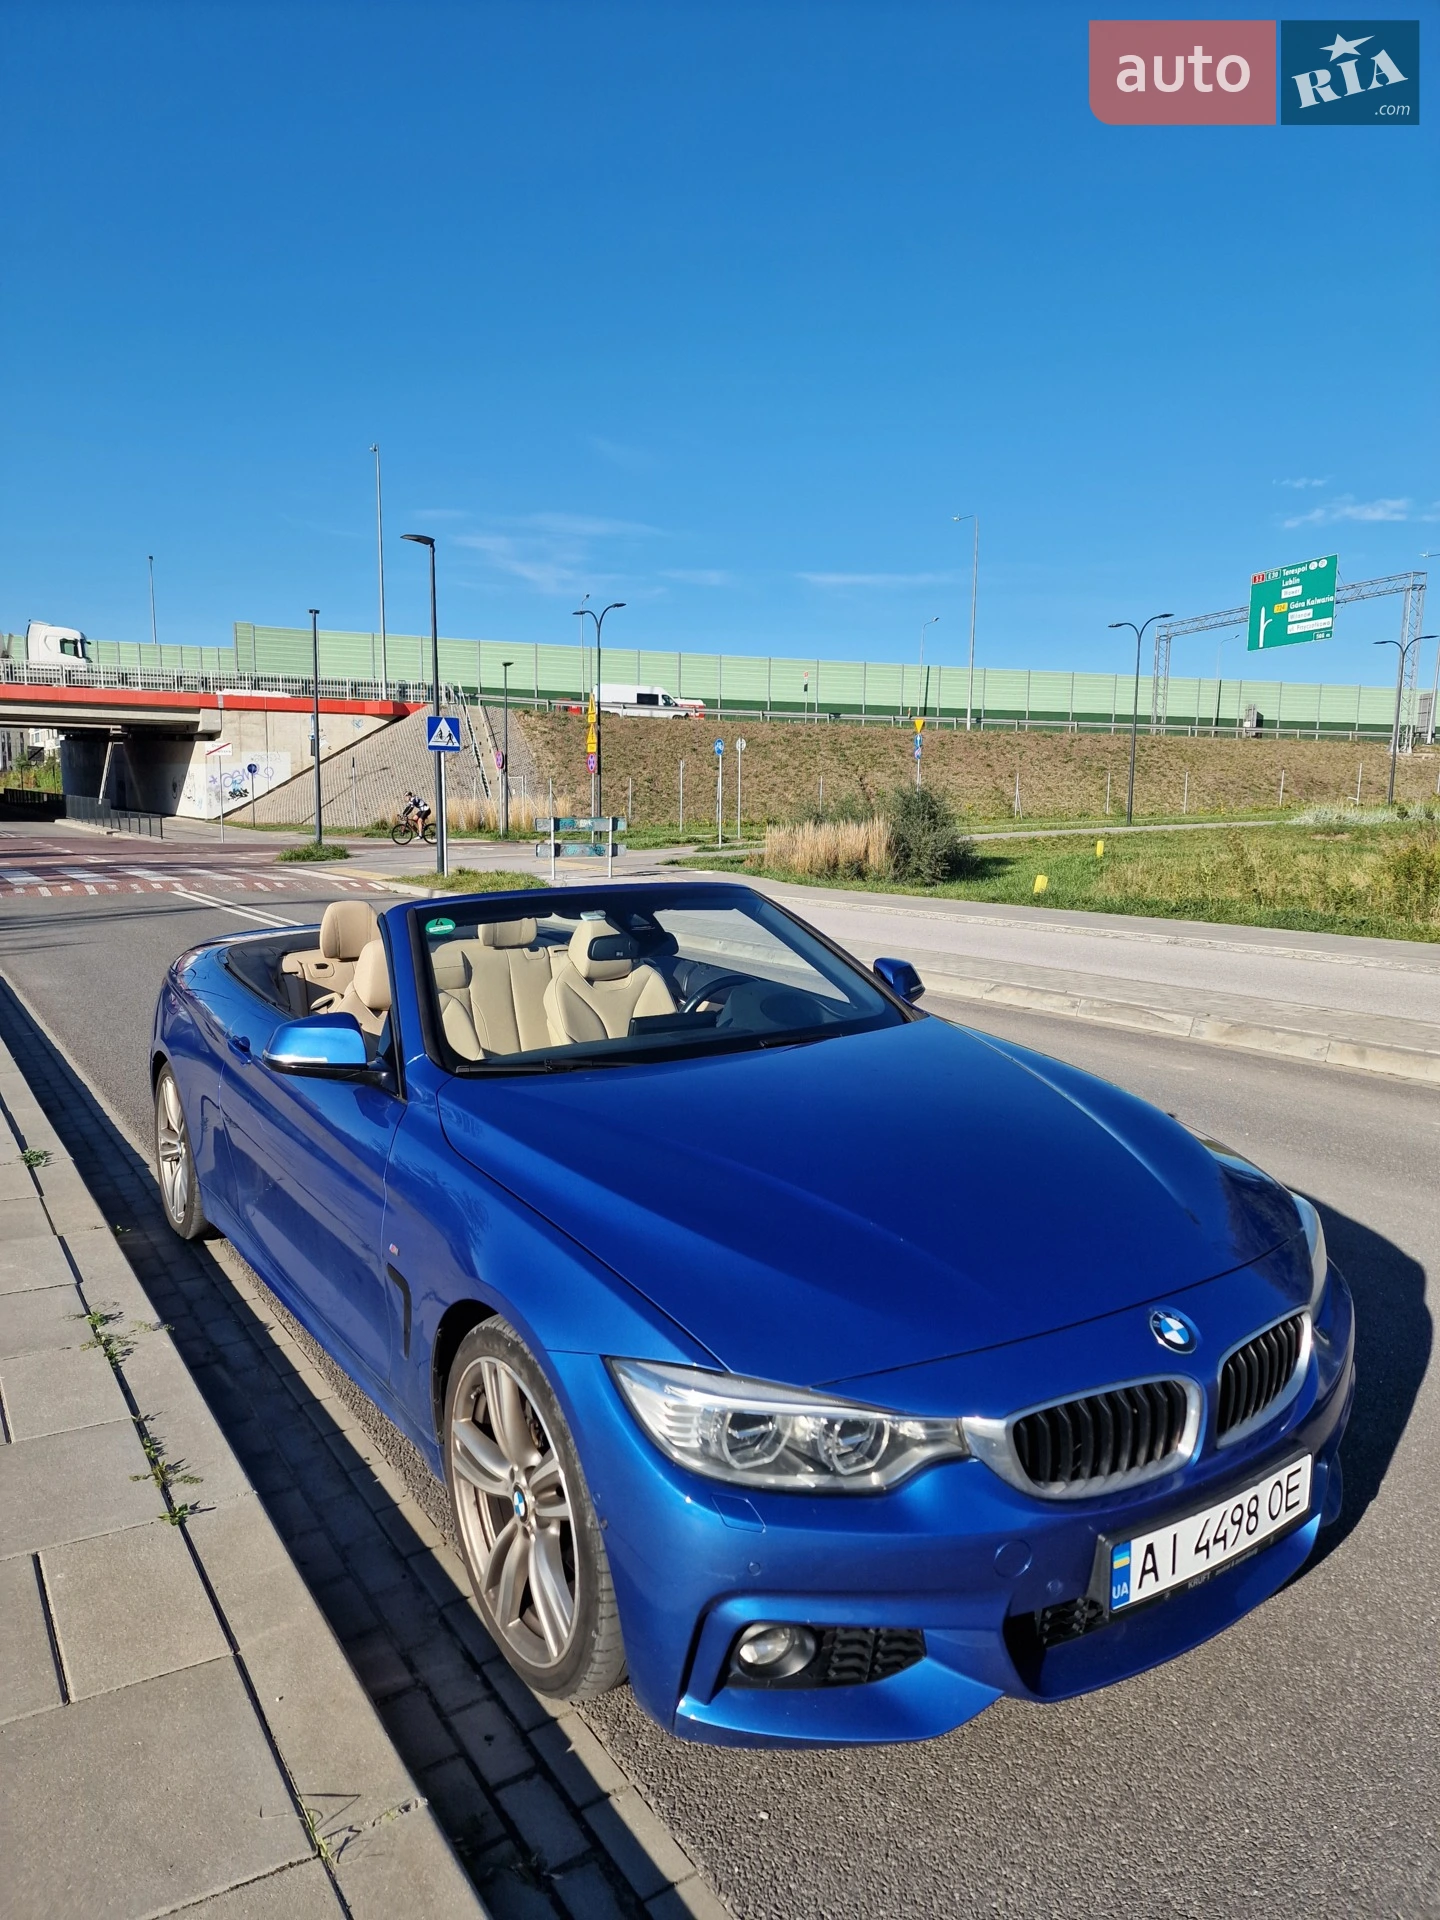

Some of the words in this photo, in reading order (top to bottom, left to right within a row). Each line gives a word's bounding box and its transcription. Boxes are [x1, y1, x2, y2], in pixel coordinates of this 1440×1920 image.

[1282, 564, 1308, 576] Terespol
[1282, 577, 1300, 587] Lublin
[1289, 601, 1306, 610] Góra
[1306, 595, 1334, 606] Kalwaria
[1137, 1532, 1179, 1590] AI
[1194, 1494, 1259, 1561] 4498
[1268, 1466, 1302, 1521] OE
[1112, 1582, 1129, 1599] UA
